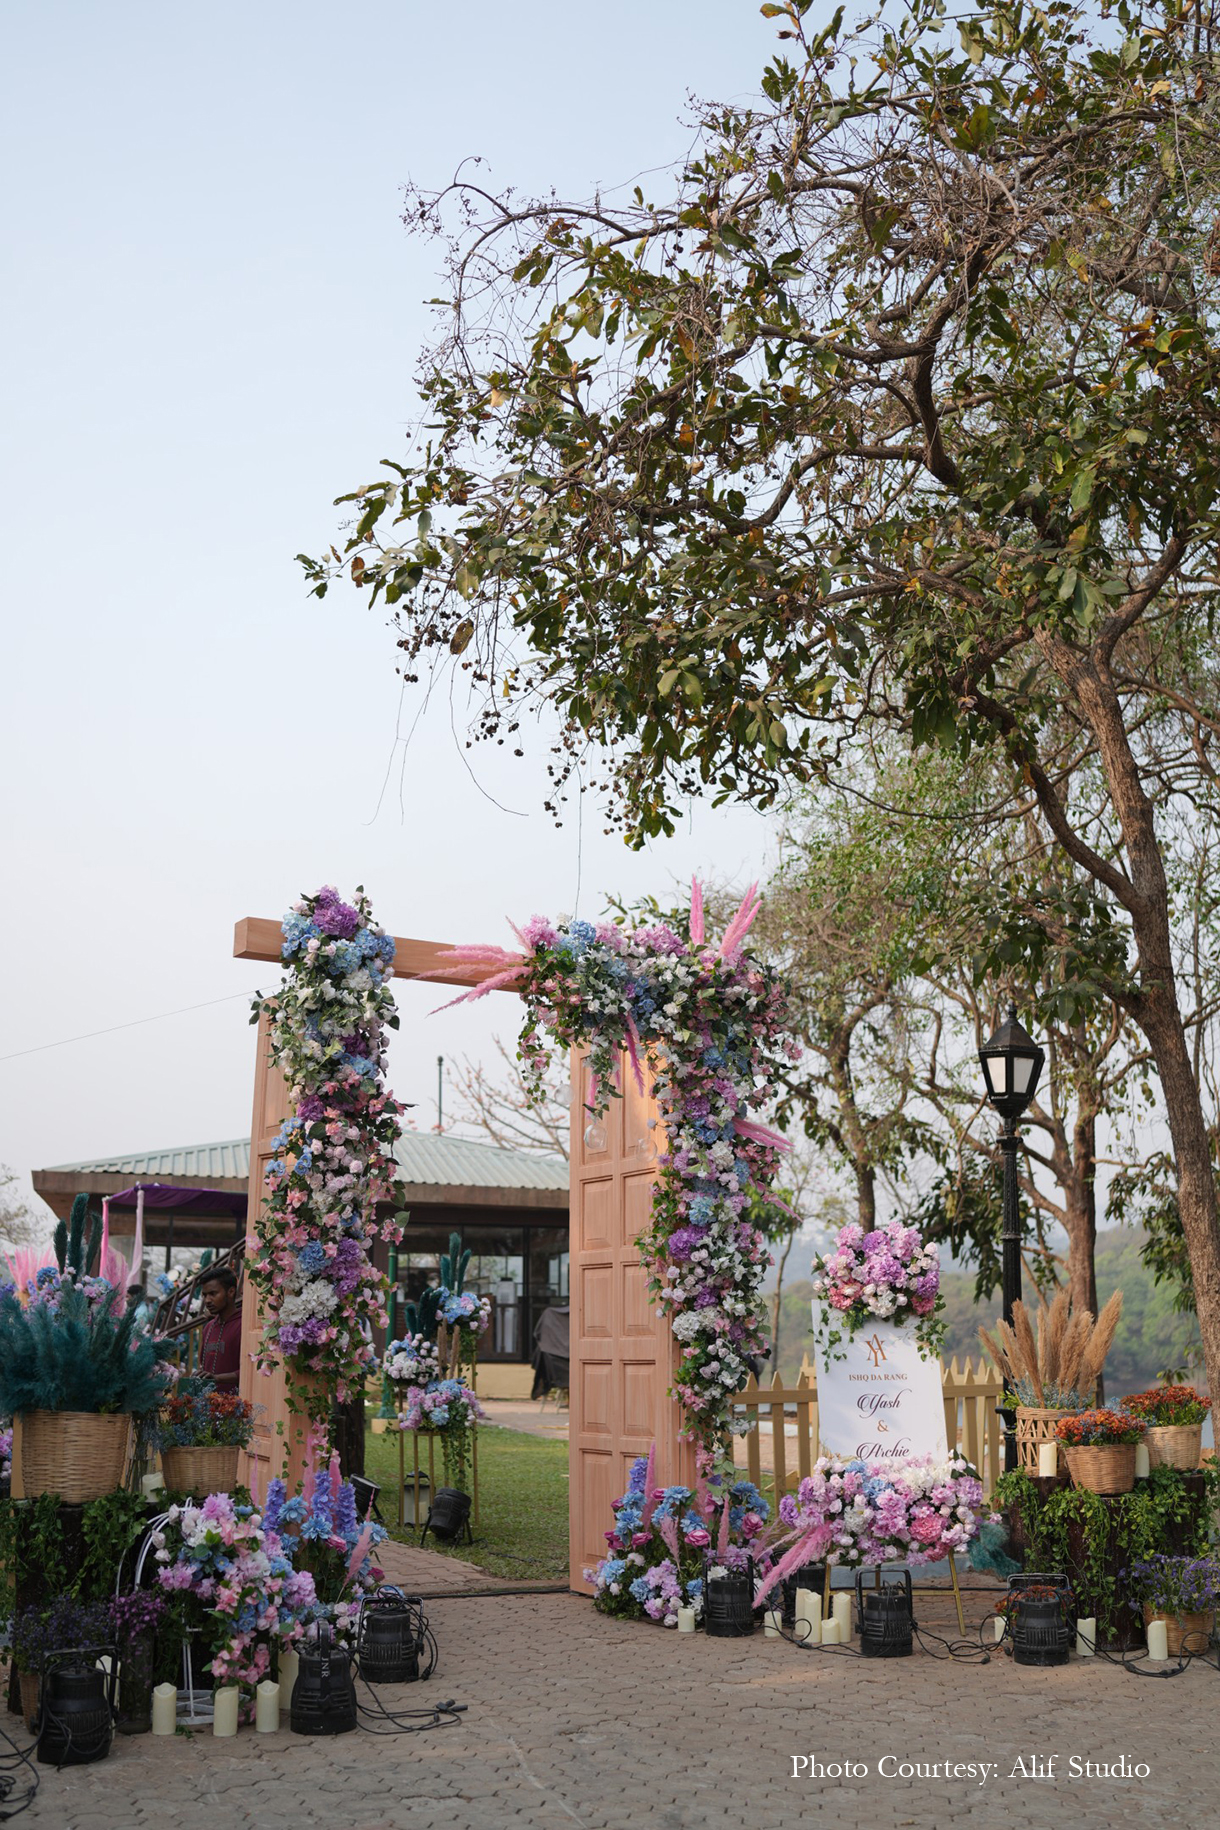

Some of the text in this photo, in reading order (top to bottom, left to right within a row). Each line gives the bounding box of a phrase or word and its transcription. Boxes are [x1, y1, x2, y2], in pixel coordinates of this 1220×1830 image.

[849, 1373, 908, 1382] ISHQ DA RANG
[857, 1388, 912, 1419] Yash
[877, 1420, 889, 1432] &
[856, 1437, 911, 1461] Archie
[321, 1657, 330, 1678] JNR
